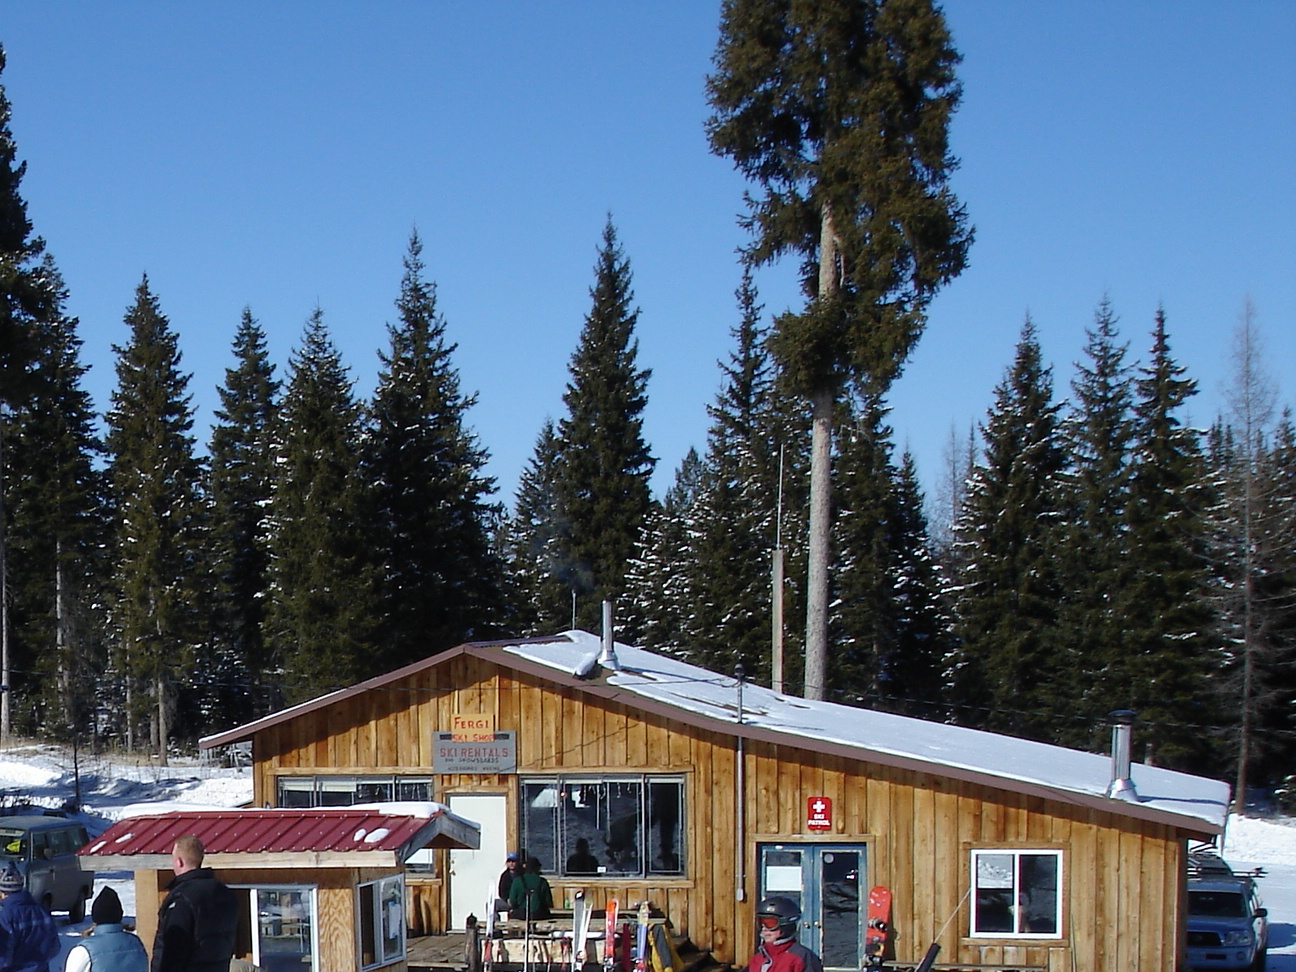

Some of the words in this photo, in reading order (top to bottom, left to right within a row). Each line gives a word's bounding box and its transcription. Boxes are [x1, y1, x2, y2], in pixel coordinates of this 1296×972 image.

[454, 716, 489, 729] FERGI
[452, 734, 467, 743] SKI
[440, 748, 457, 757] SKI
[461, 748, 508, 757] RENTALS
